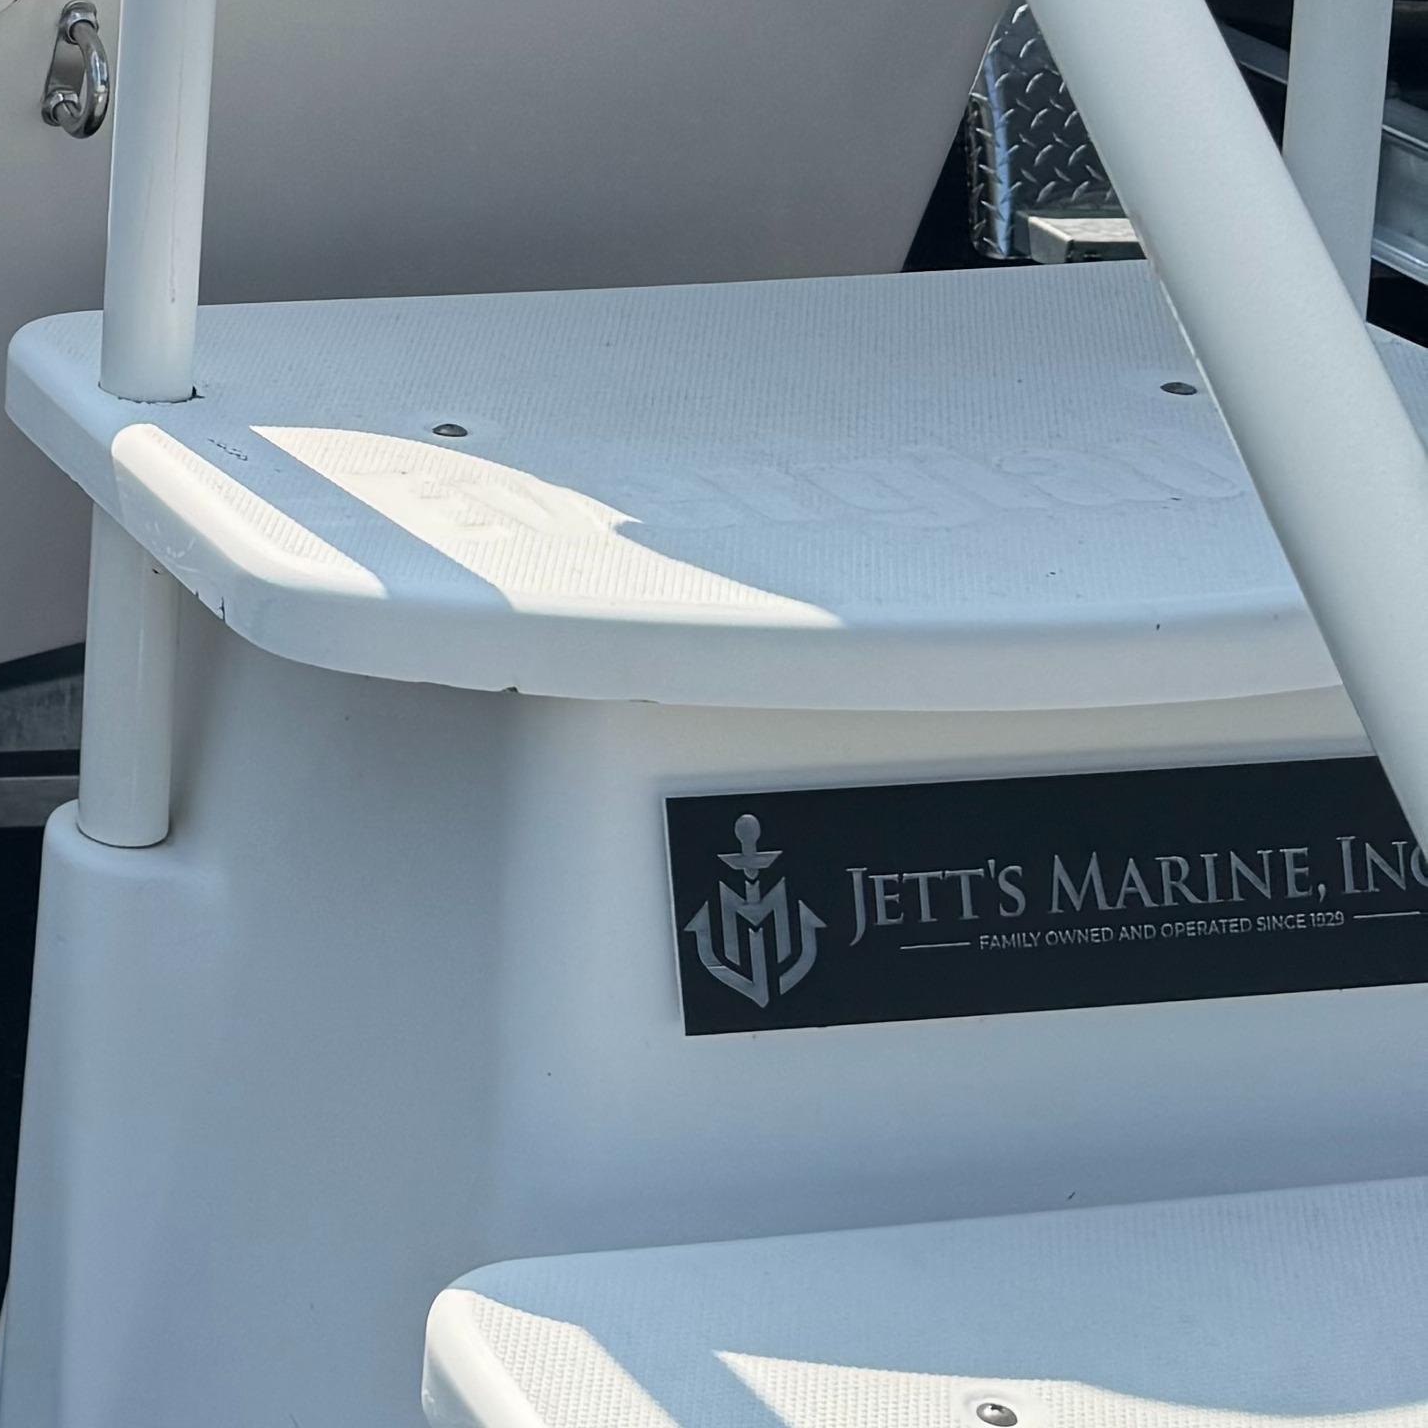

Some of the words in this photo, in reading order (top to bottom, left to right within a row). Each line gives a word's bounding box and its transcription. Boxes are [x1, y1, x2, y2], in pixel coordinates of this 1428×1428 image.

[845, 859, 1027, 947] JETT'S
[1048, 847, 1328, 914] MARINE,
[979, 931, 1041, 951] FAMILY
[1045, 927, 1114, 947] OWNED
[1118, 923, 1156, 942] AND
[1161, 916, 1252, 939] OPERATED
[1256, 913, 1307, 933] SINCE
